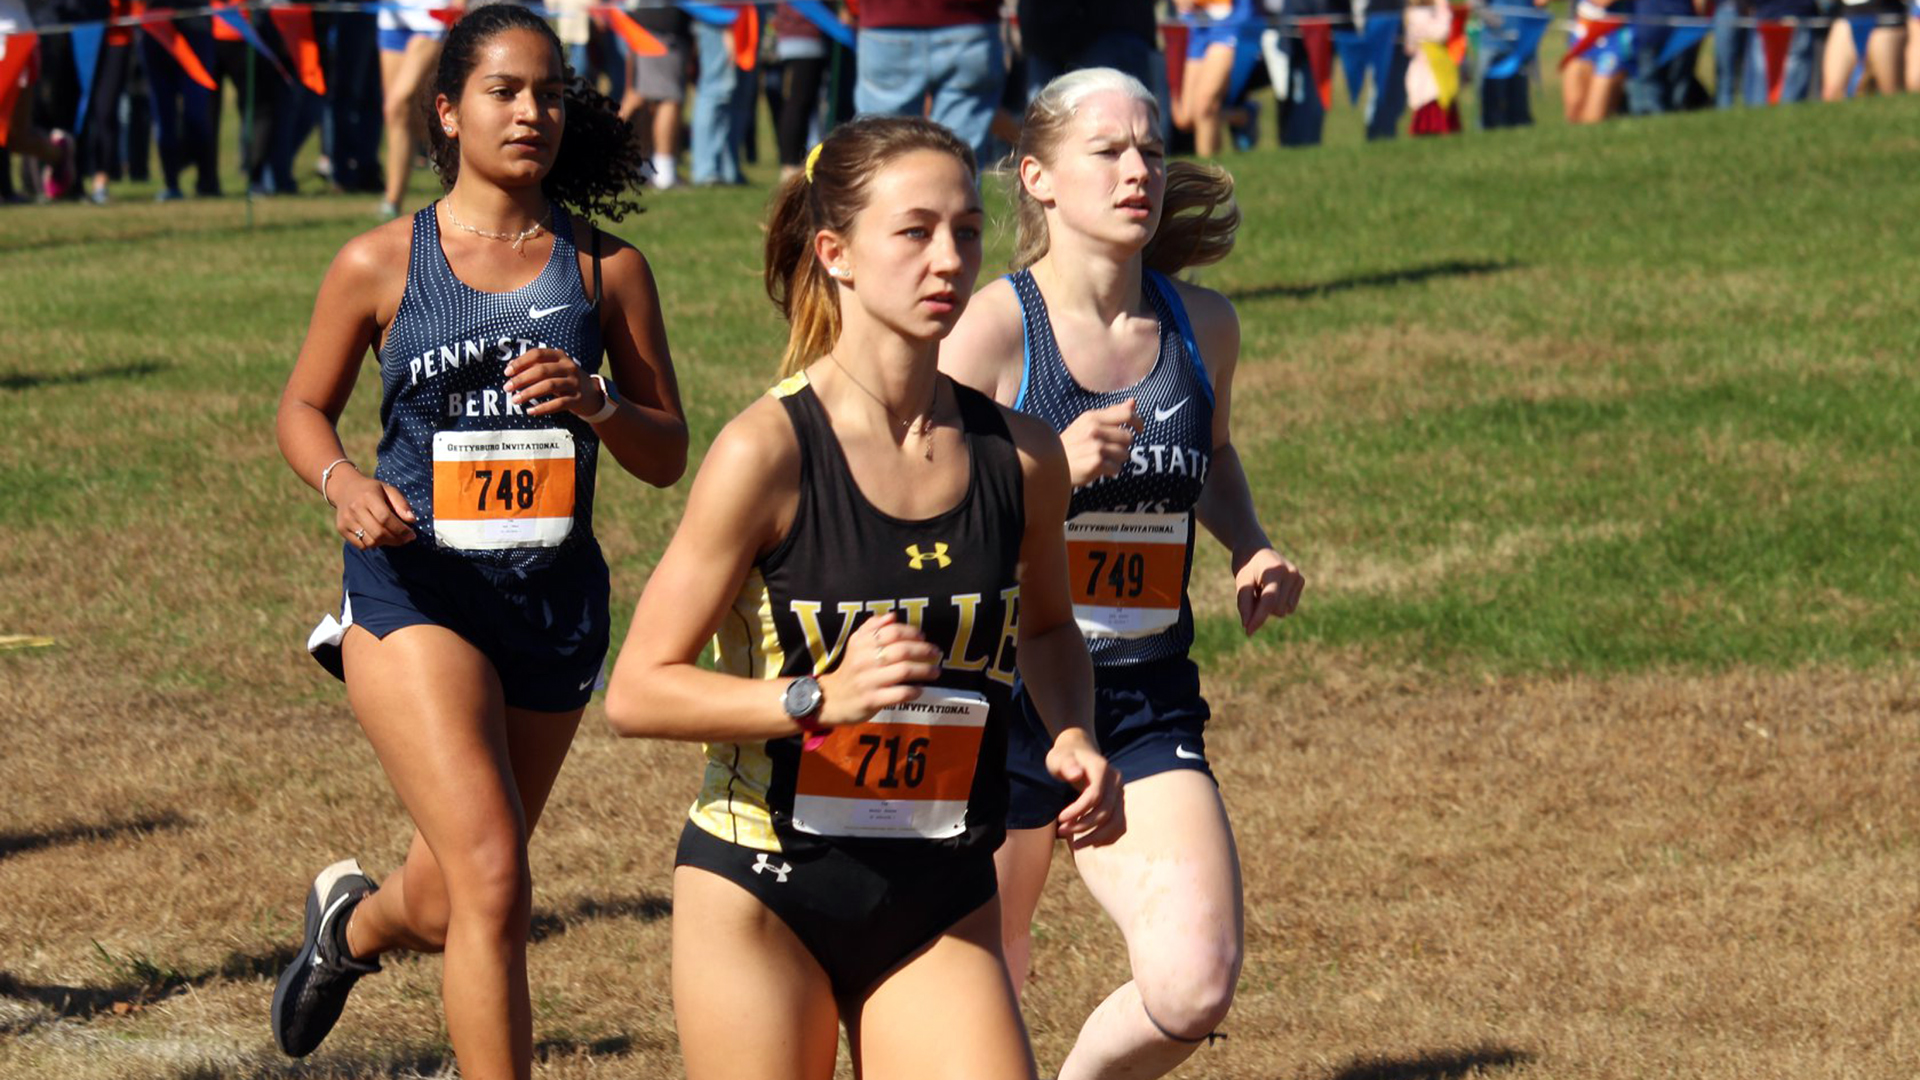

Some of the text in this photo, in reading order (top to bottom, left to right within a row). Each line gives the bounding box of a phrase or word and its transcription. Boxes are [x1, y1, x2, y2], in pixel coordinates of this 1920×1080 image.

[409, 337, 485, 386] PENN
[448, 388, 540, 417] BERK
[1130, 444, 1209, 485] STATE
[475, 469, 534, 511] 748
[1086, 551, 1144, 598] 749
[898, 702, 970, 715] INVITATIONAL
[854, 735, 929, 788] 716
